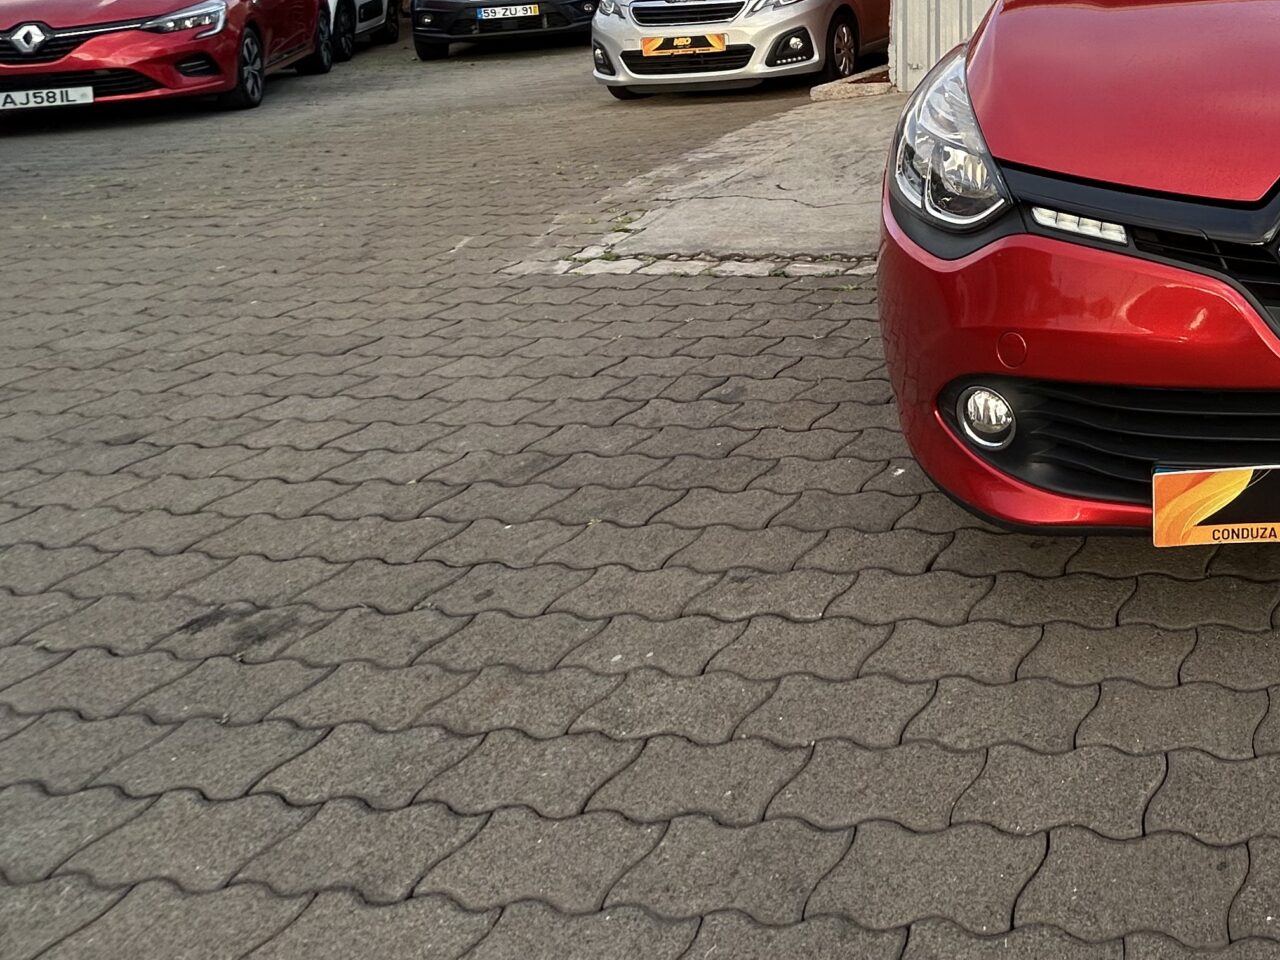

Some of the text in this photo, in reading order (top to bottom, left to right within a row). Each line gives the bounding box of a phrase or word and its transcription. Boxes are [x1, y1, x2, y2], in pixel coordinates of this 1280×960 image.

[483, 8, 497, 18] 59
[501, 7, 517, 17] ZU
[1211, 526, 1278, 541] CONDUZA
